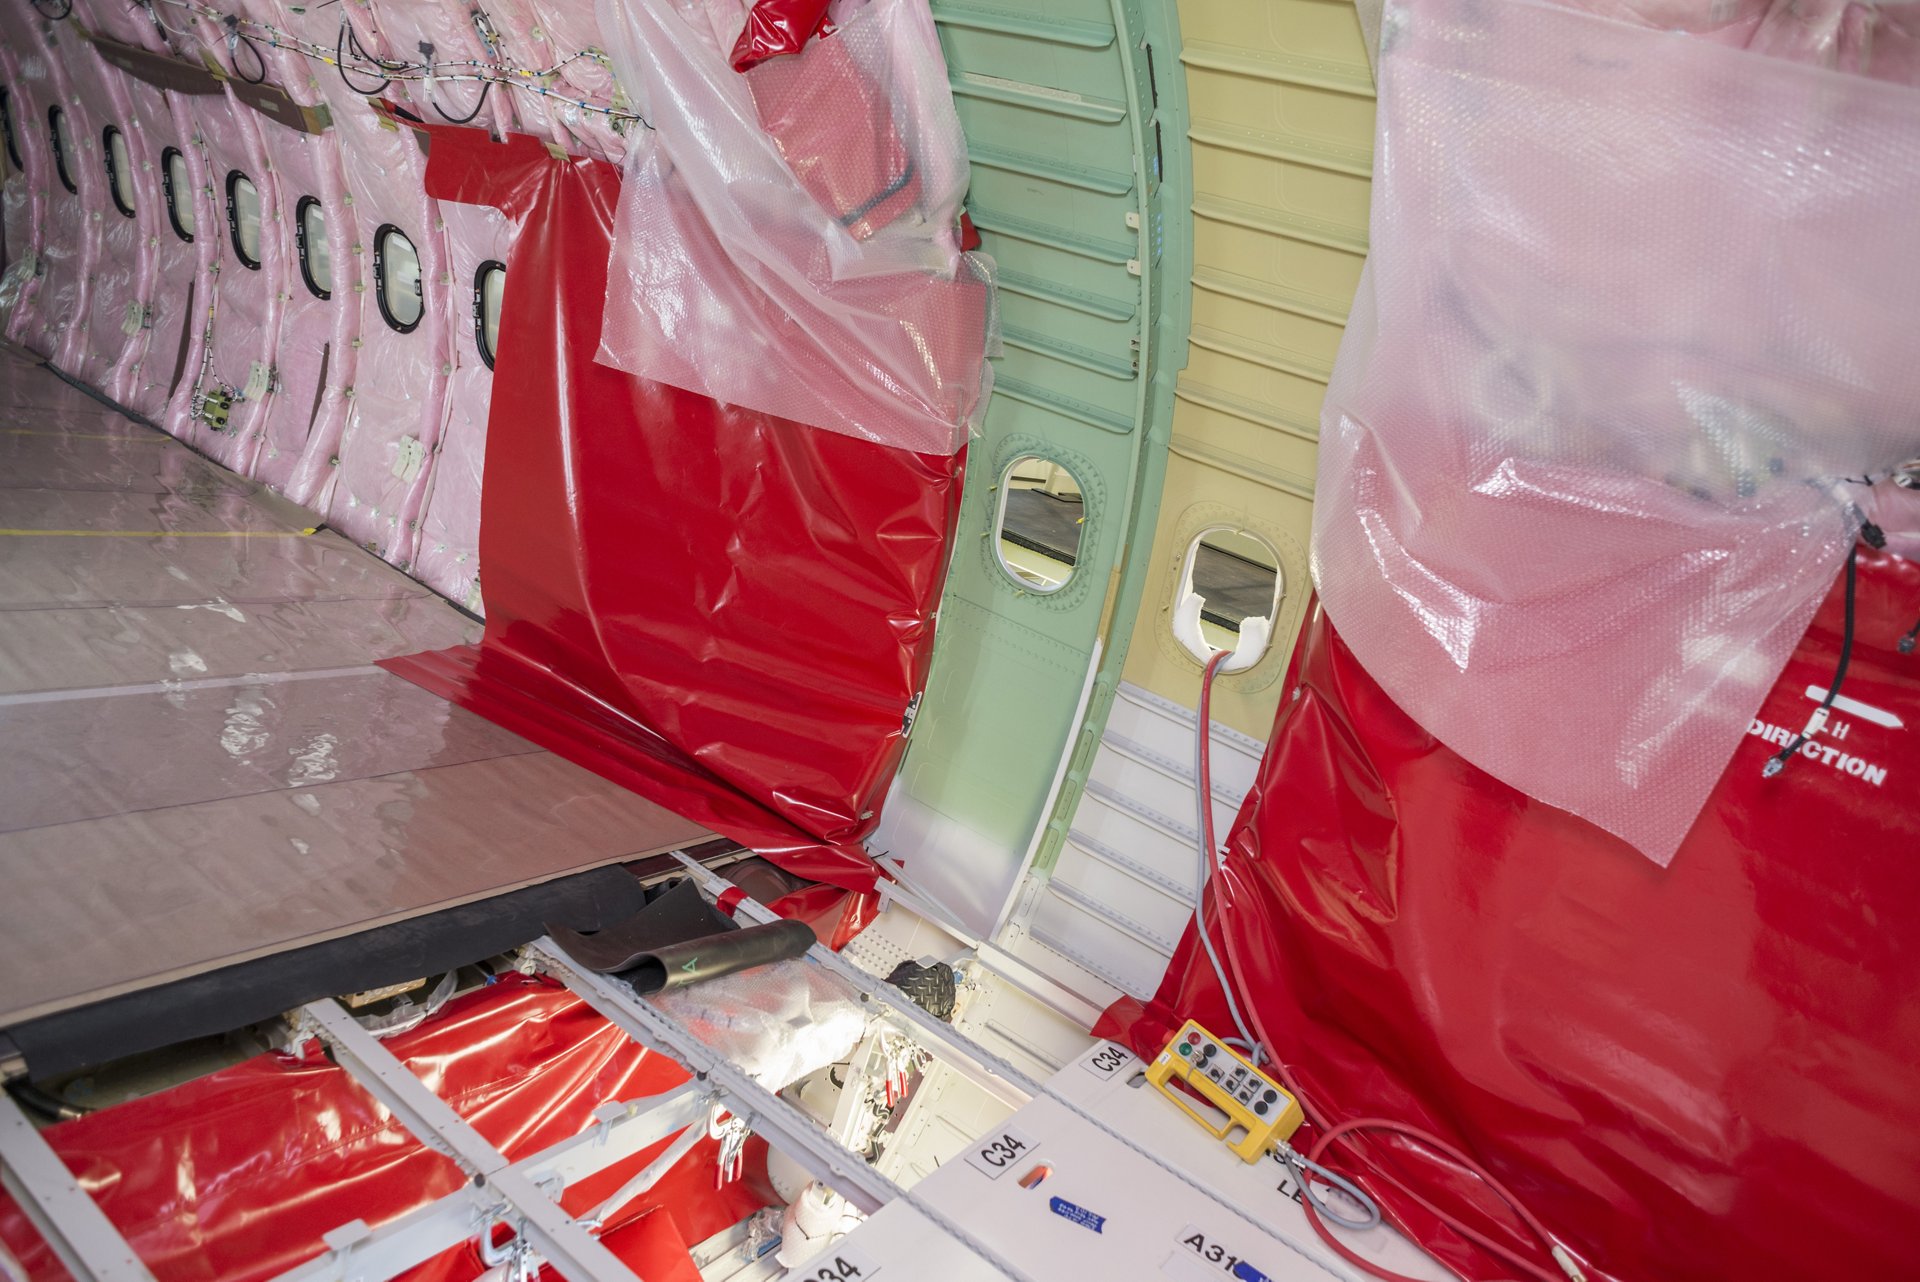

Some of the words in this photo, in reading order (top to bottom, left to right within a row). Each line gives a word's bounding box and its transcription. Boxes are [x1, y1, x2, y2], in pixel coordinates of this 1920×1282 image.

[1092, 1047, 1128, 1071] C34
[981, 1134, 1026, 1167] C34
[802, 1257, 861, 1282] 34
[1184, 1233, 1244, 1282] A31
